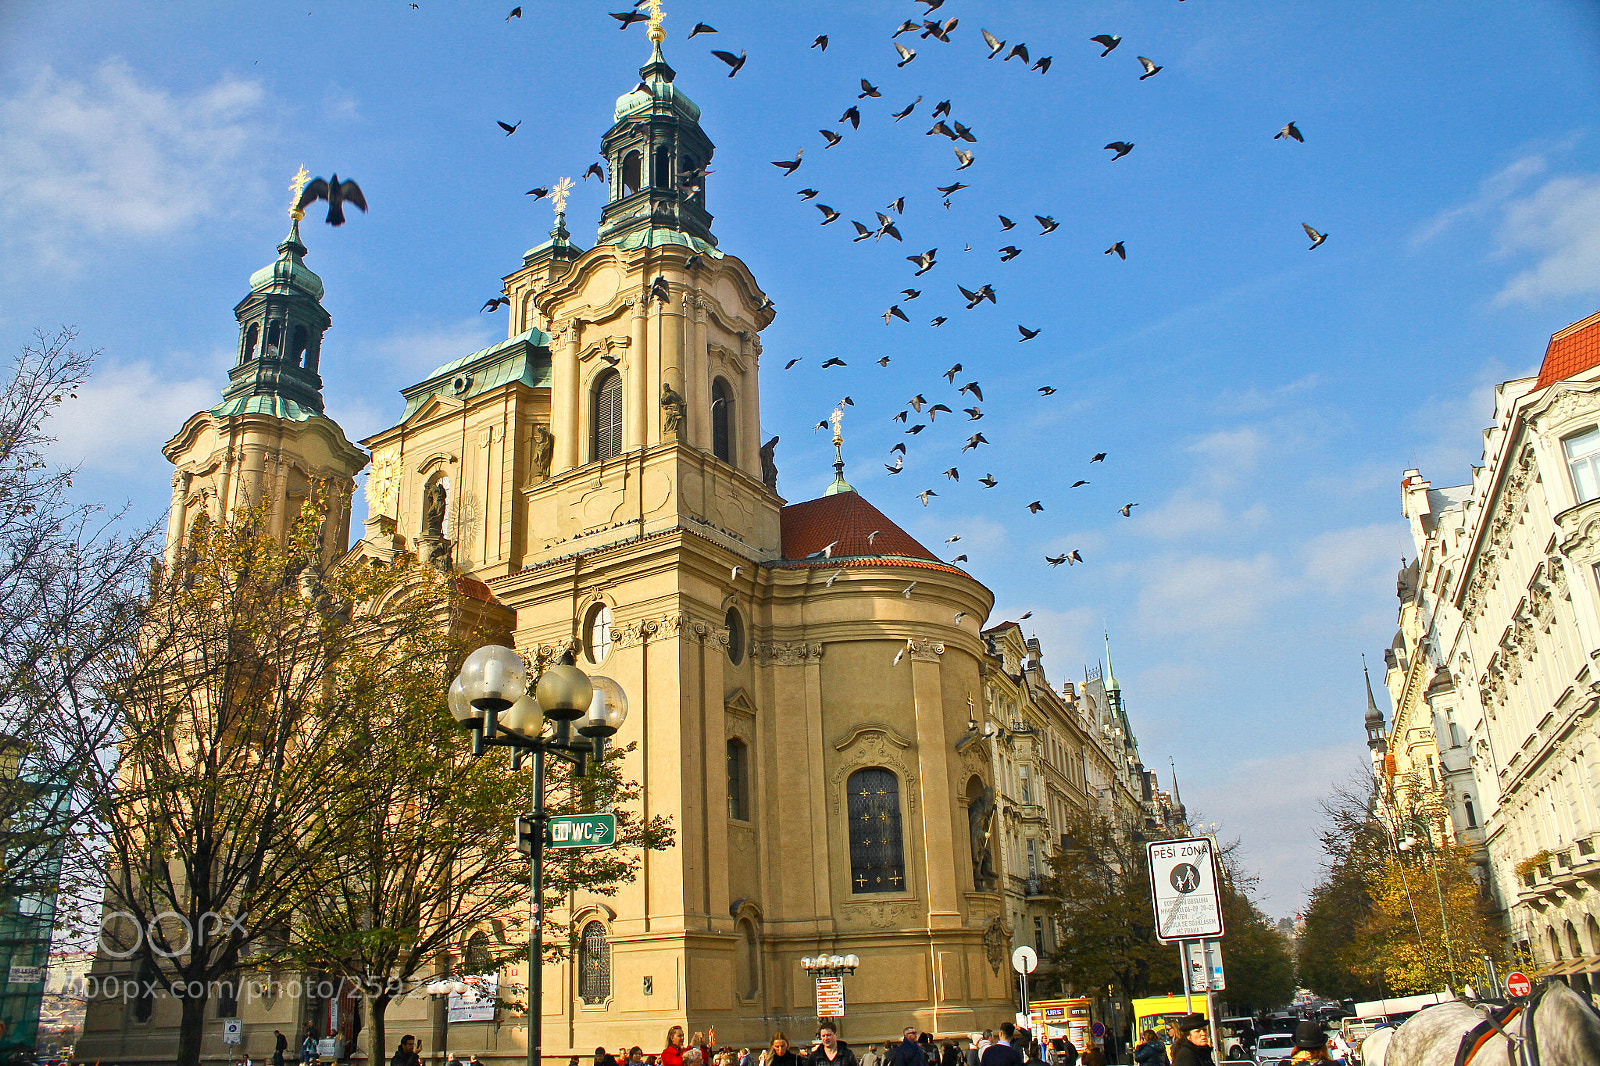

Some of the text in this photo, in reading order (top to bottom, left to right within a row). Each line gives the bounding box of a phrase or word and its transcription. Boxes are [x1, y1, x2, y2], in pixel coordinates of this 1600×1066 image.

[572, 822, 592, 840] WC
[1153, 843, 1208, 859] PĚŠÍ ZÓNA
